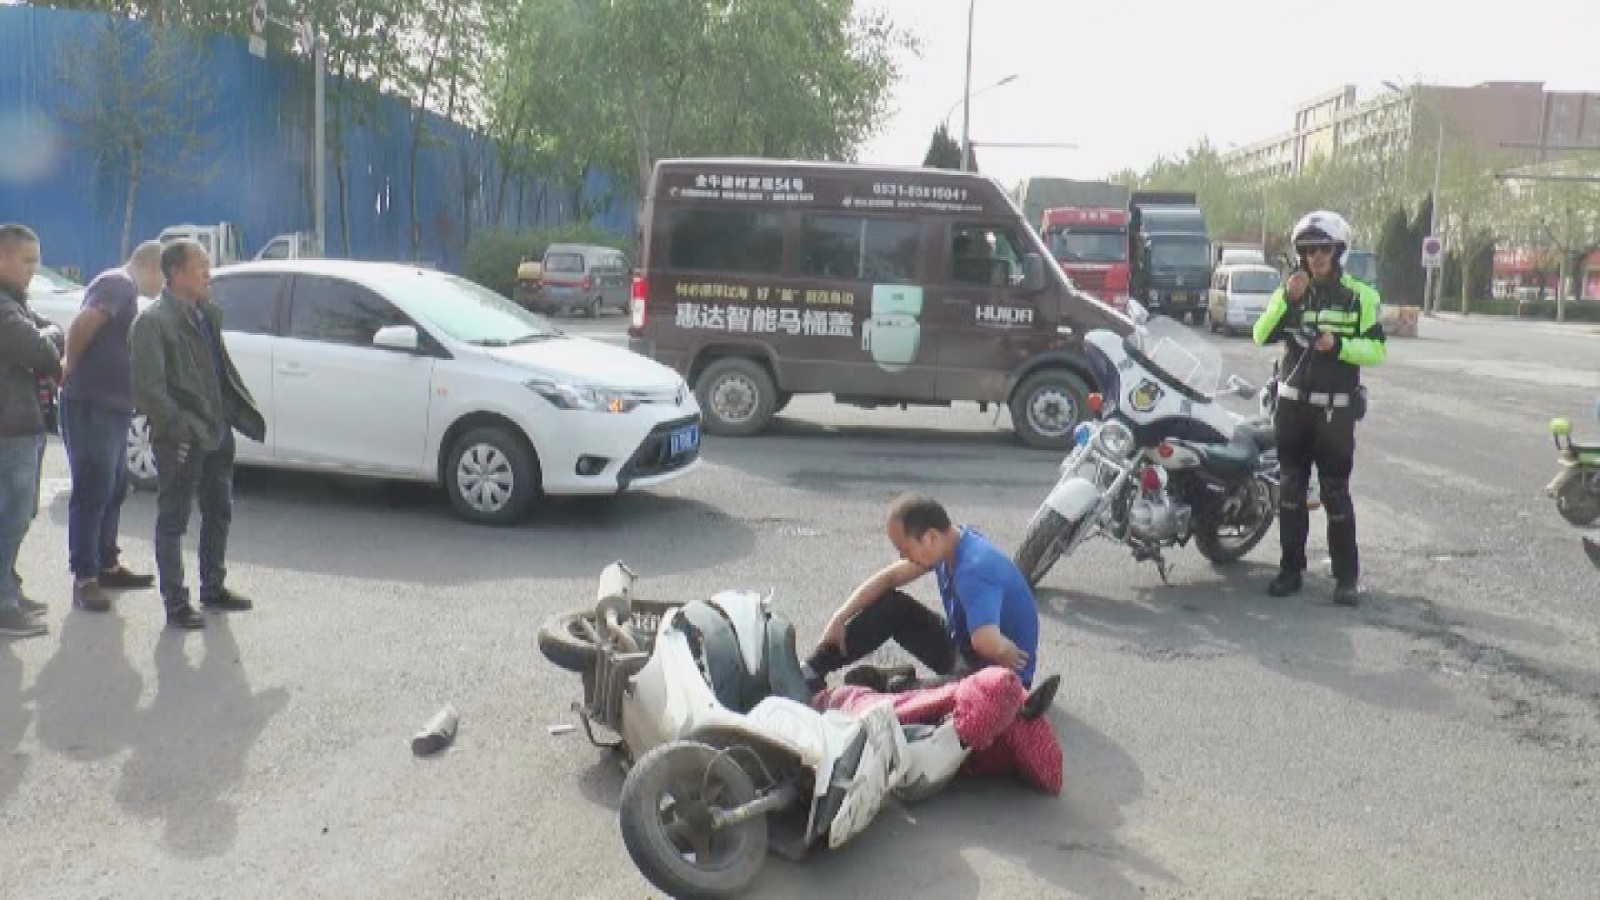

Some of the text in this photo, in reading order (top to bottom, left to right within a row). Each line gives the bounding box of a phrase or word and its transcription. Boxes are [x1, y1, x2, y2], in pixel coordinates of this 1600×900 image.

[675, 302, 853, 336] 惠达智能马桶盖
